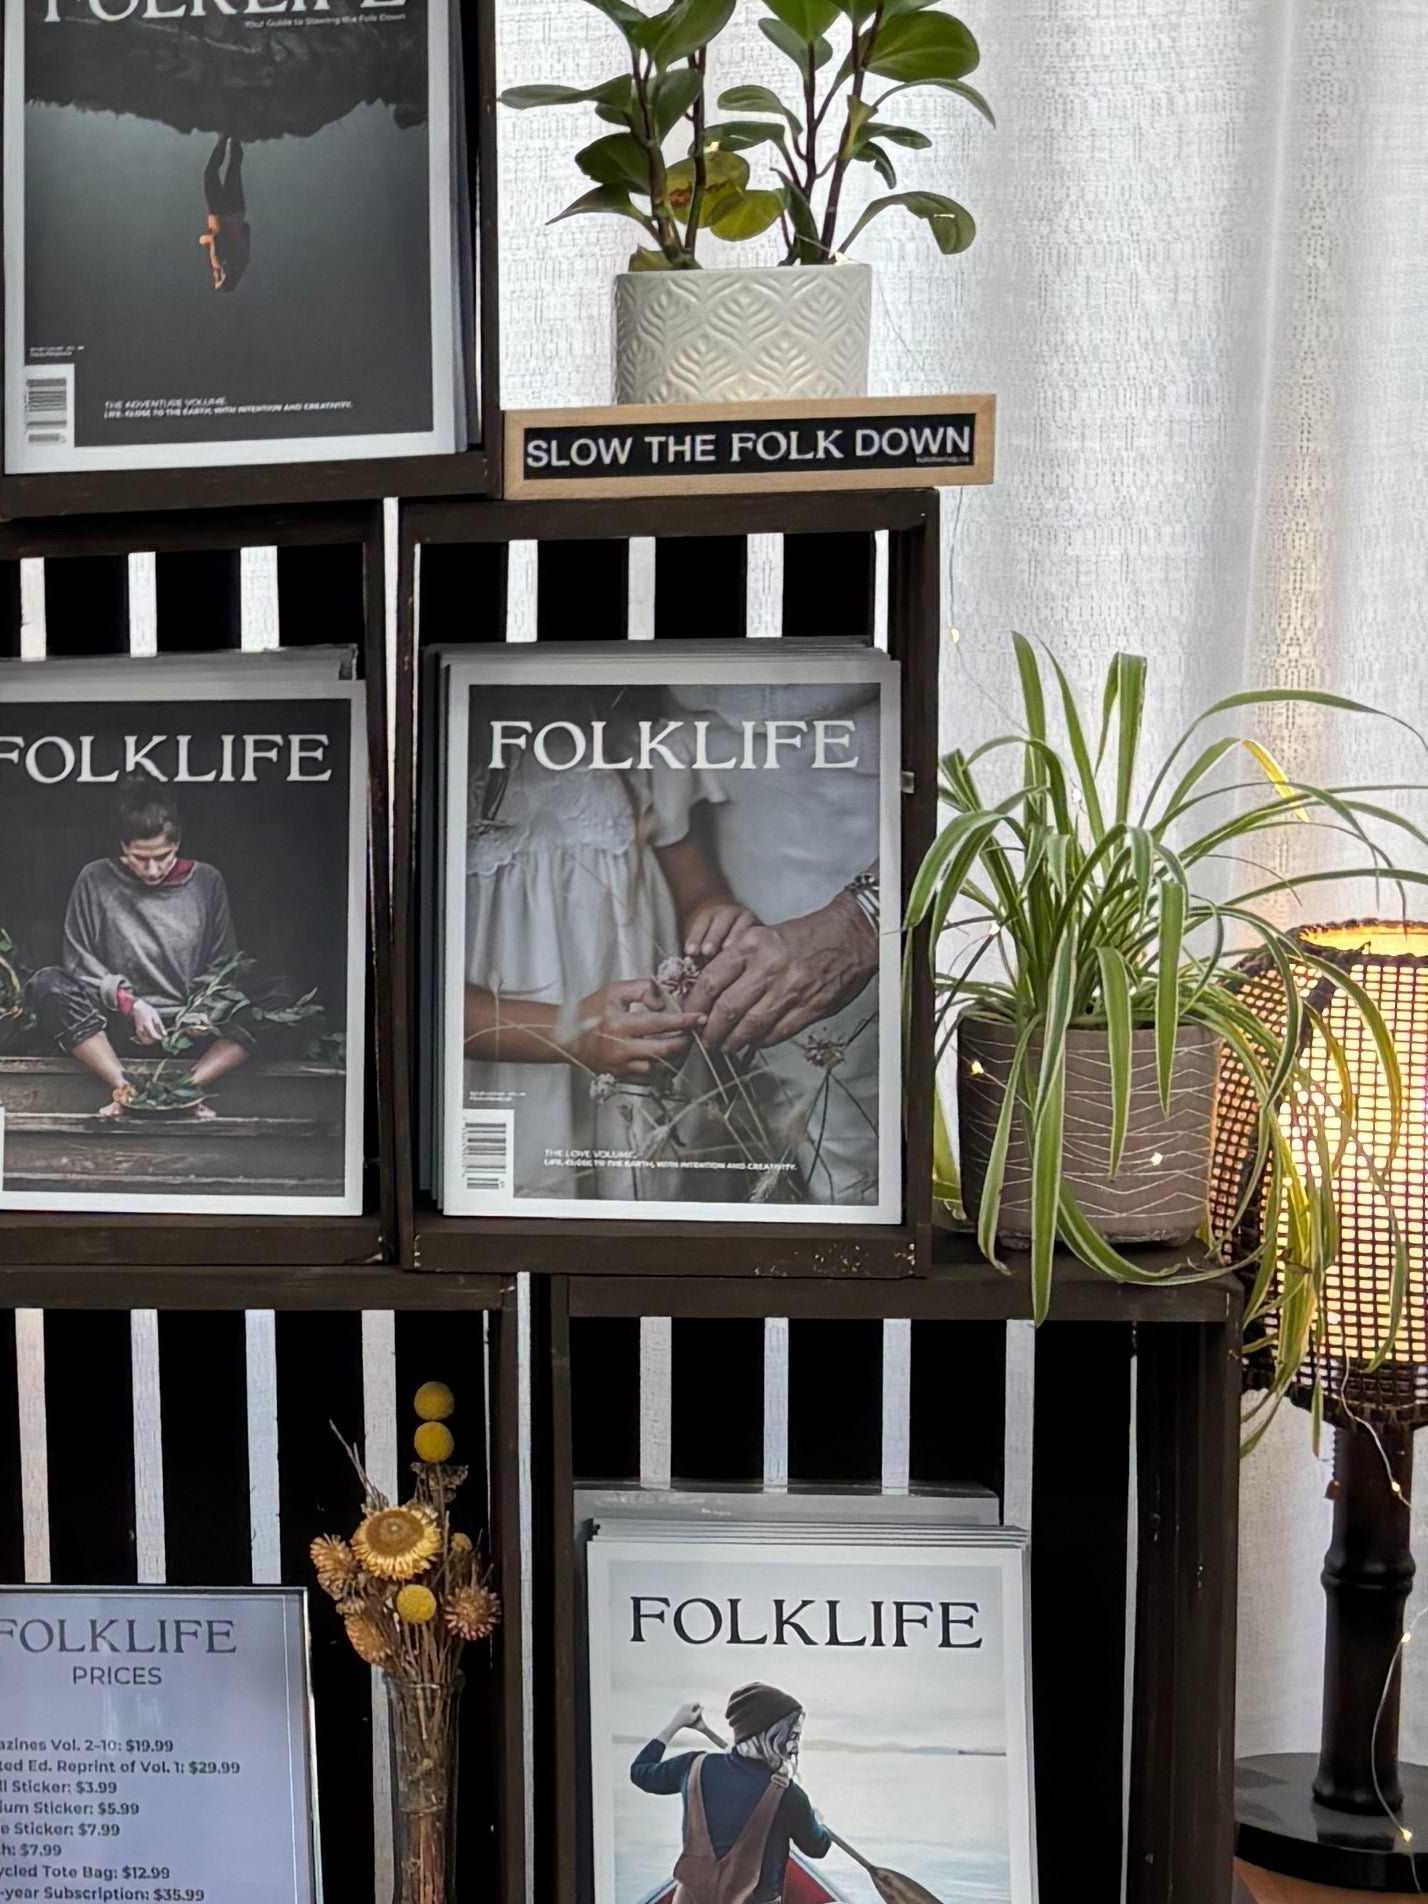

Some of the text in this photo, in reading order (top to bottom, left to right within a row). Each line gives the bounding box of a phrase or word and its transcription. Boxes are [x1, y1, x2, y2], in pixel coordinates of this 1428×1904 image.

[525, 425, 971, 468] SLOW THE FOLK DOWN
[487, 719, 860, 771] FOLKLIFE
[630, 1596, 983, 1649] FOLKLIFE
[72, 1665, 162, 1686] PRICES
[51, 1738, 80, 1751] Vol.
[125, 1739, 174, 1753] $19.99
[28, 1759, 53, 1772] Ed.
[57, 1759, 116, 1775] Reprint
[120, 1760, 136, 1773] of
[140, 1760, 170, 1774] Vol.
[188, 1761, 240, 1775] $29.99
[12, 1779, 71, 1793] Sticker:
[76, 1781, 117, 1794] $3.99
[33, 1800, 93, 1815] Sticker:
[97, 1802, 140, 1816] $5.99
[14, 1821, 74, 1836] Sticker:
[78, 1823, 120, 1837] $7.99
[20, 1843, 62, 1857] $7.99
[42, 1865, 77, 1878] Tote
[83, 1866, 118, 1882] Bag:
[122, 1865, 170, 1879] $12.99
[43, 1886, 149, 1903] Subscription:
